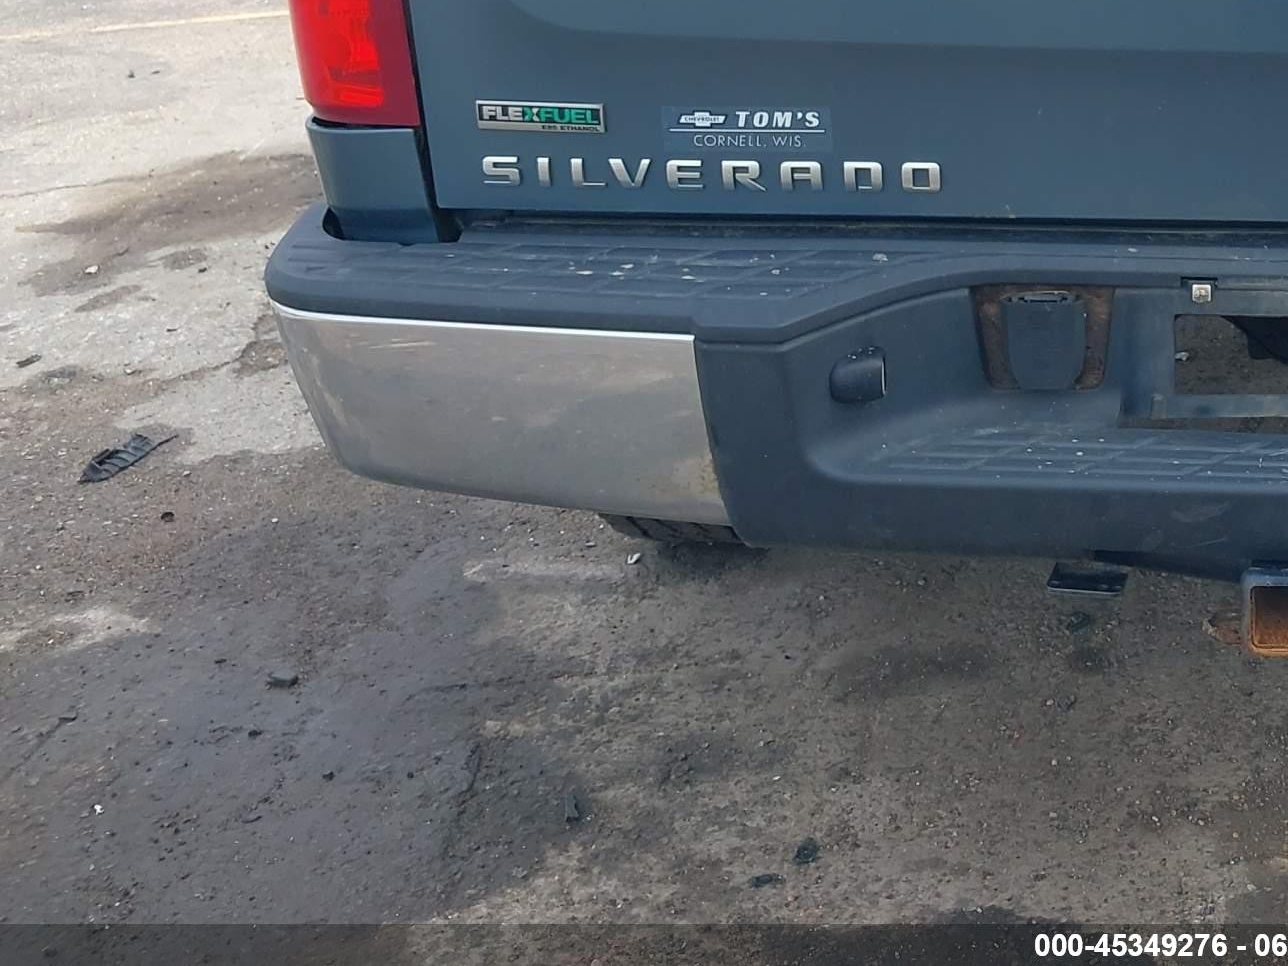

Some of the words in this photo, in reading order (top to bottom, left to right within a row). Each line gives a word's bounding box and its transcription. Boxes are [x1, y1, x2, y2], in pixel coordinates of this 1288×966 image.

[482, 105, 600, 124] FLEXFUEL
[735, 110, 820, 128] TOM'S
[771, 135, 806, 148] WIS.
[482, 155, 942, 192] SILVERADO
